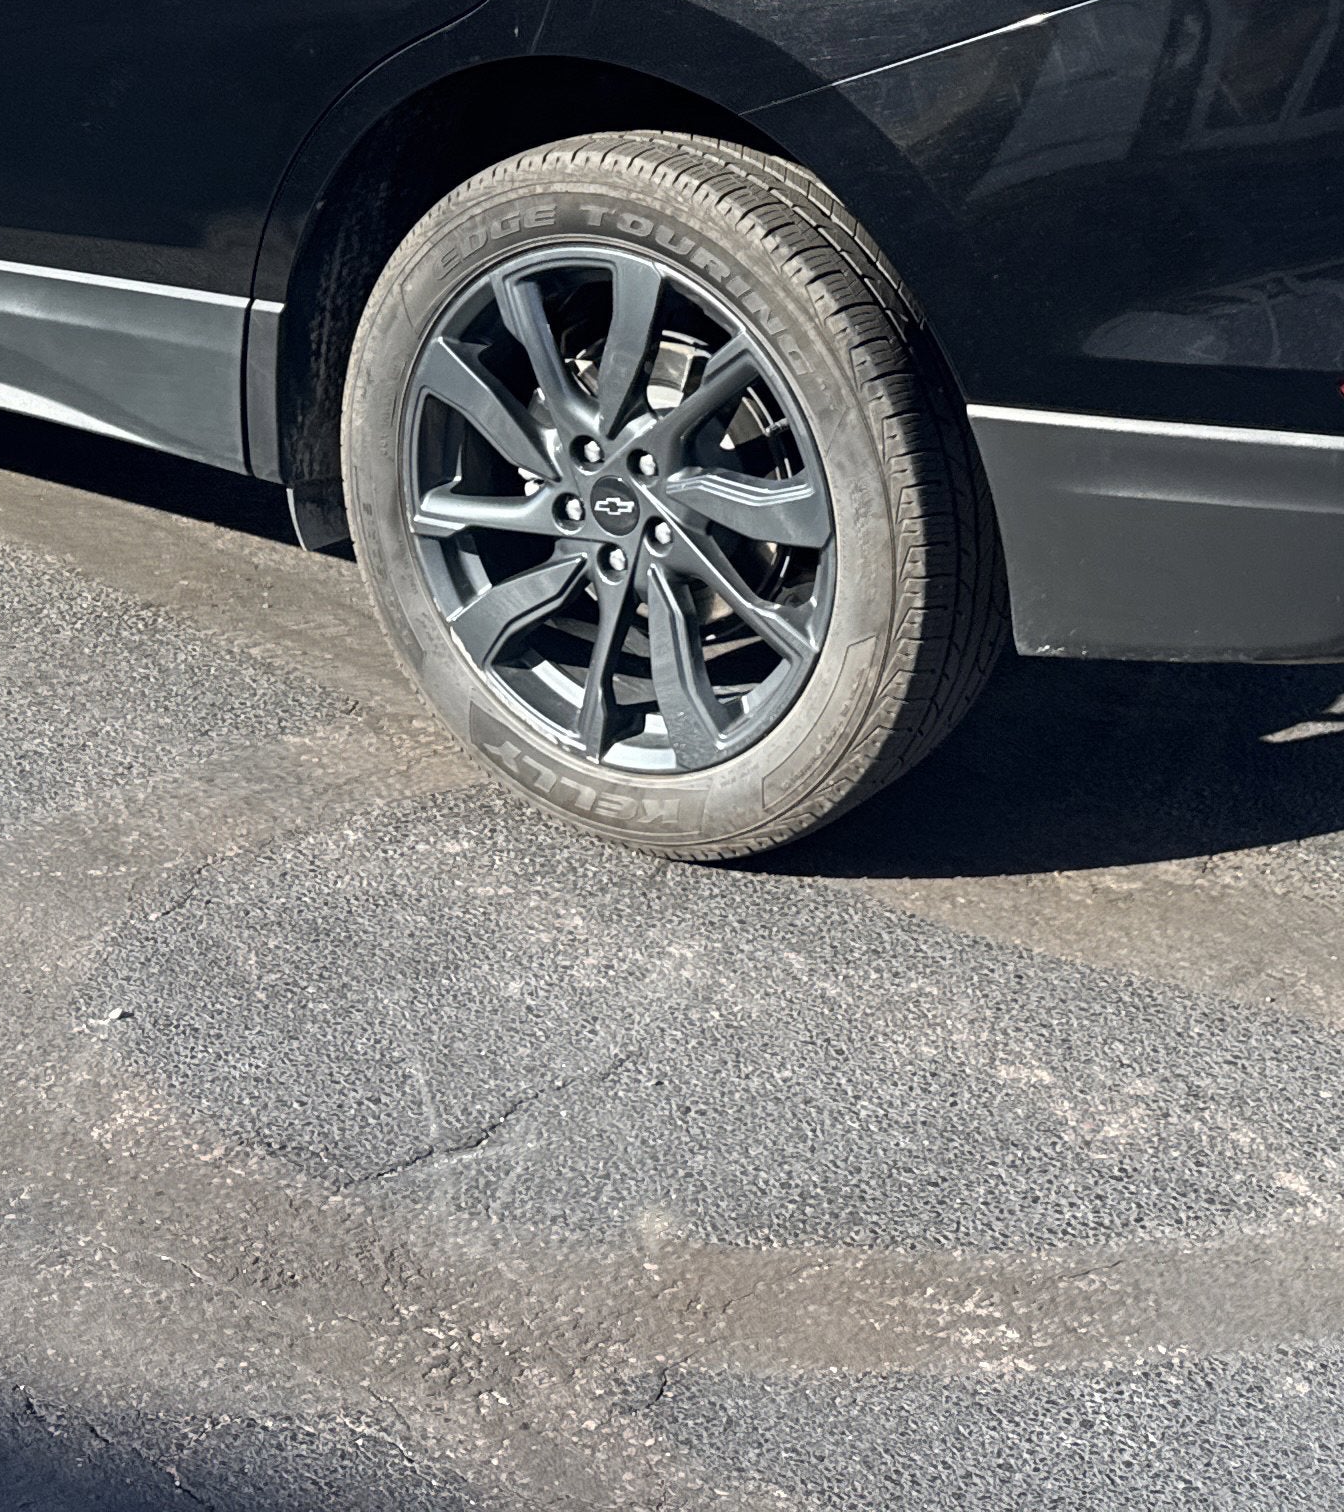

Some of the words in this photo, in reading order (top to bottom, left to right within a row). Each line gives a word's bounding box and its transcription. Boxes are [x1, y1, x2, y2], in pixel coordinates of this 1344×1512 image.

[437, 205, 557, 281] EDGE
[579, 204, 816, 376] TOURING
[483, 739, 681, 824] KELLY
